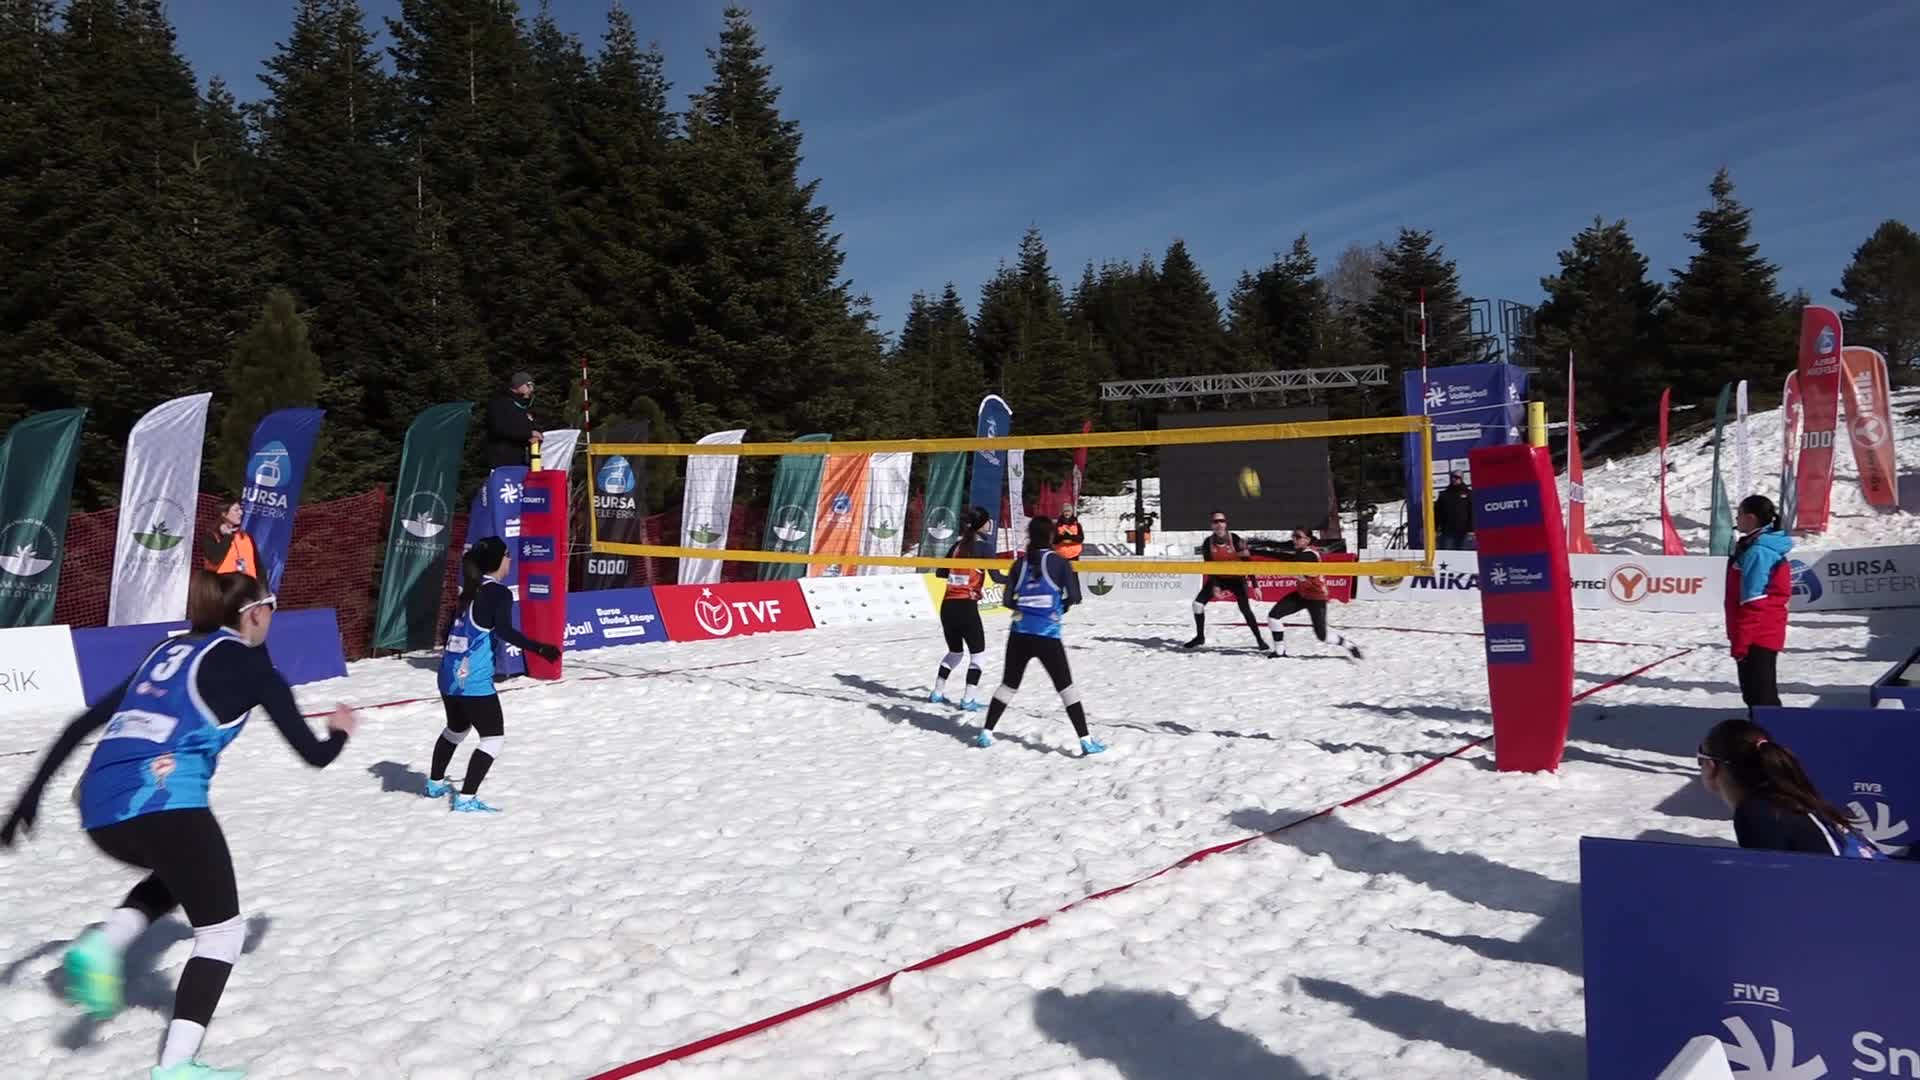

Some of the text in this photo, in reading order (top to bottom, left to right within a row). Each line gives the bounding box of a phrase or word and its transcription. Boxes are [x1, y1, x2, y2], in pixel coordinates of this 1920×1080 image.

[1484, 498, 1529, 512] COURT 1
[1827, 559, 1897, 577] BURSA
[732, 600, 781, 625] TVF
[151, 645, 194, 681] 3
[1853, 782, 1882, 793] FIVB
[1733, 983, 1781, 1002] FIVB
